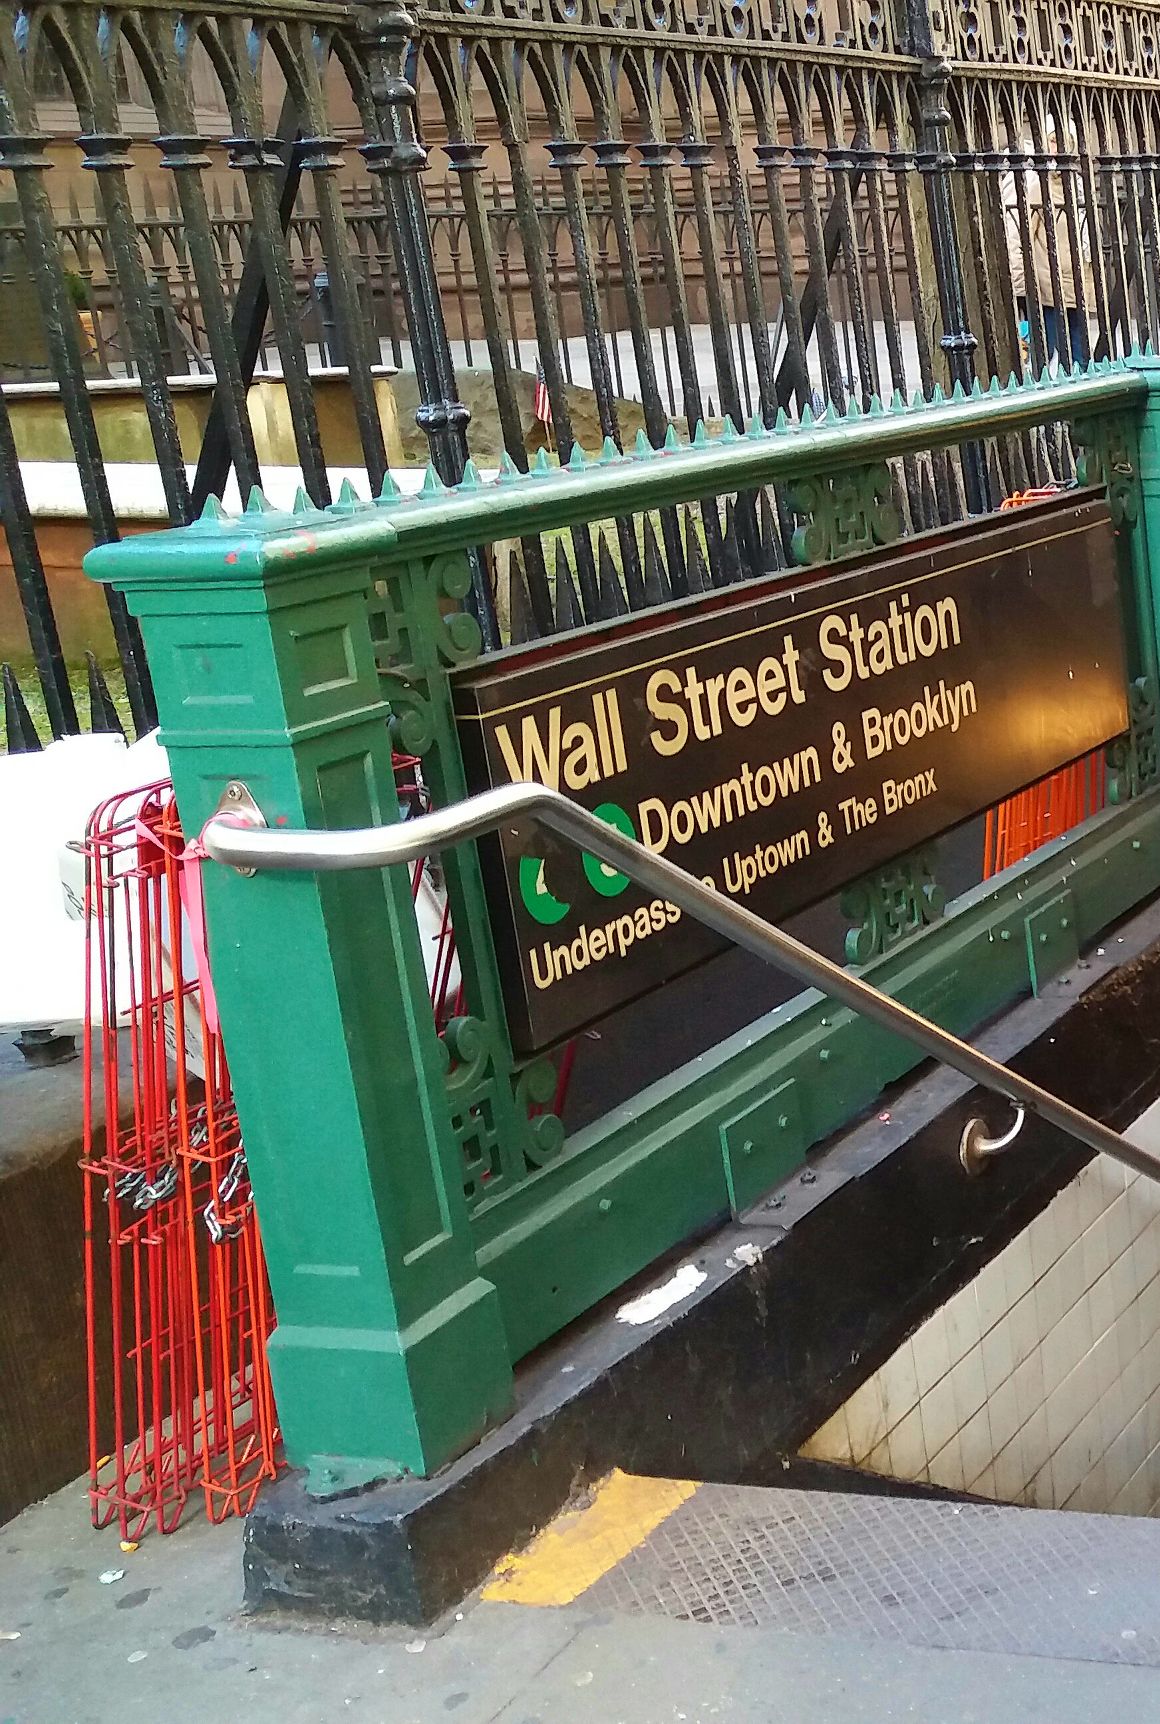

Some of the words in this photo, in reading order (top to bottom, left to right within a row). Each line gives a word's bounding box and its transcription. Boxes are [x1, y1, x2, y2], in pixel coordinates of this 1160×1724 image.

[494, 686, 628, 792] Wall
[645, 633, 807, 757] Street
[818, 592, 961, 693] Station
[638, 744, 822, 855] Downtown
[831, 721, 856, 774] &
[861, 678, 978, 759] Brooklyn
[528, 899, 681, 990] Underpass
[721, 836, 811, 896] Uptown
[817, 810, 836, 850] &
[837, 798, 880, 835] The
[882, 768, 938, 816] Bronx
